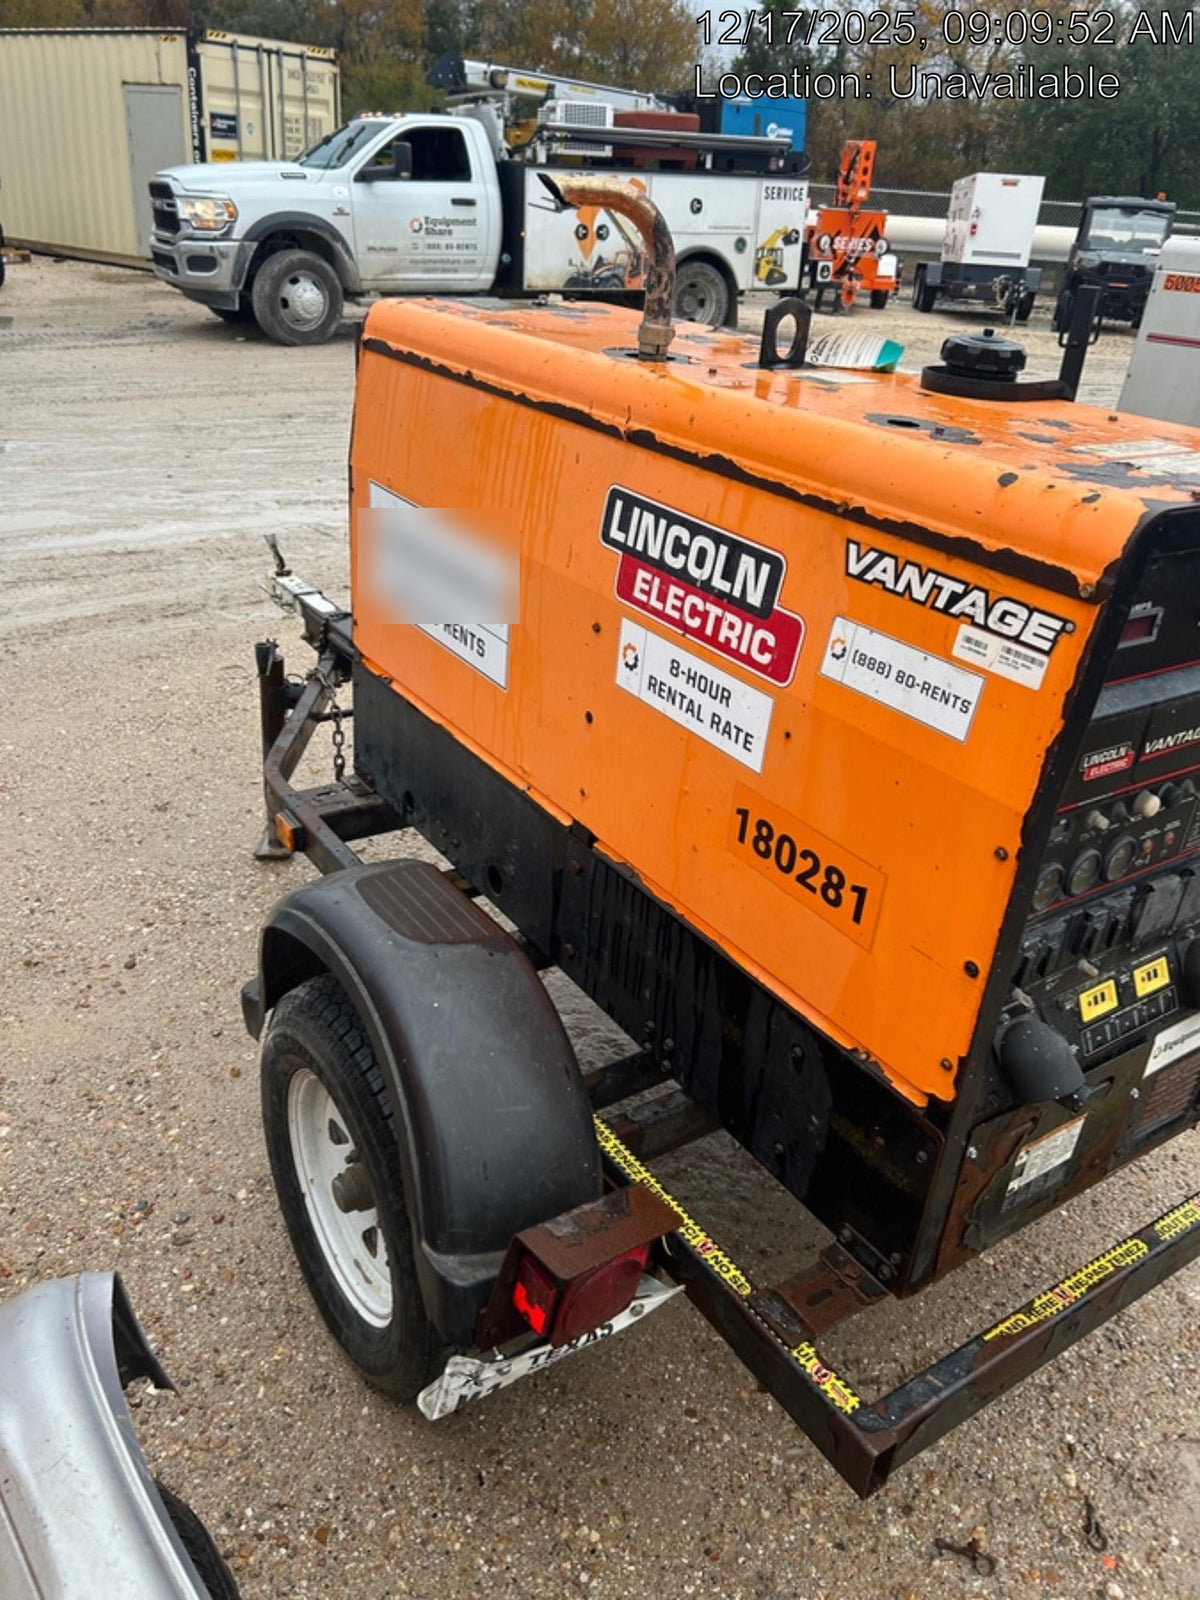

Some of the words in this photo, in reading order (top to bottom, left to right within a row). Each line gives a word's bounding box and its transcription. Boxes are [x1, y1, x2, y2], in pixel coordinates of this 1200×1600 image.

[764, 185, 804, 202] SERVICE
[424, 217, 477, 228] Equipment
[424, 227, 453, 236] Share
[608, 498, 771, 609] LINCOLN
[632, 568, 777, 666] ELECTRIC
[847, 541, 1062, 650] VANTAGE
[669, 658, 733, 708] 8-HOUR
[851, 648, 892, 680] (888)
[895, 669, 973, 715] 80-RENTS
[647, 674, 705, 724] RENTAL
[709, 712, 755, 754] RATE
[1083, 744, 1129, 767] LINCOLN
[735, 807, 869, 925] 180281
[710, 1255, 732, 1275] NO
[728, 1273, 751, 1294] SE
[1068, 1278, 1089, 1294] NE
[1086, 1262, 1111, 1283] PAS
[1108, 1240, 1146, 1266] TENEZ
